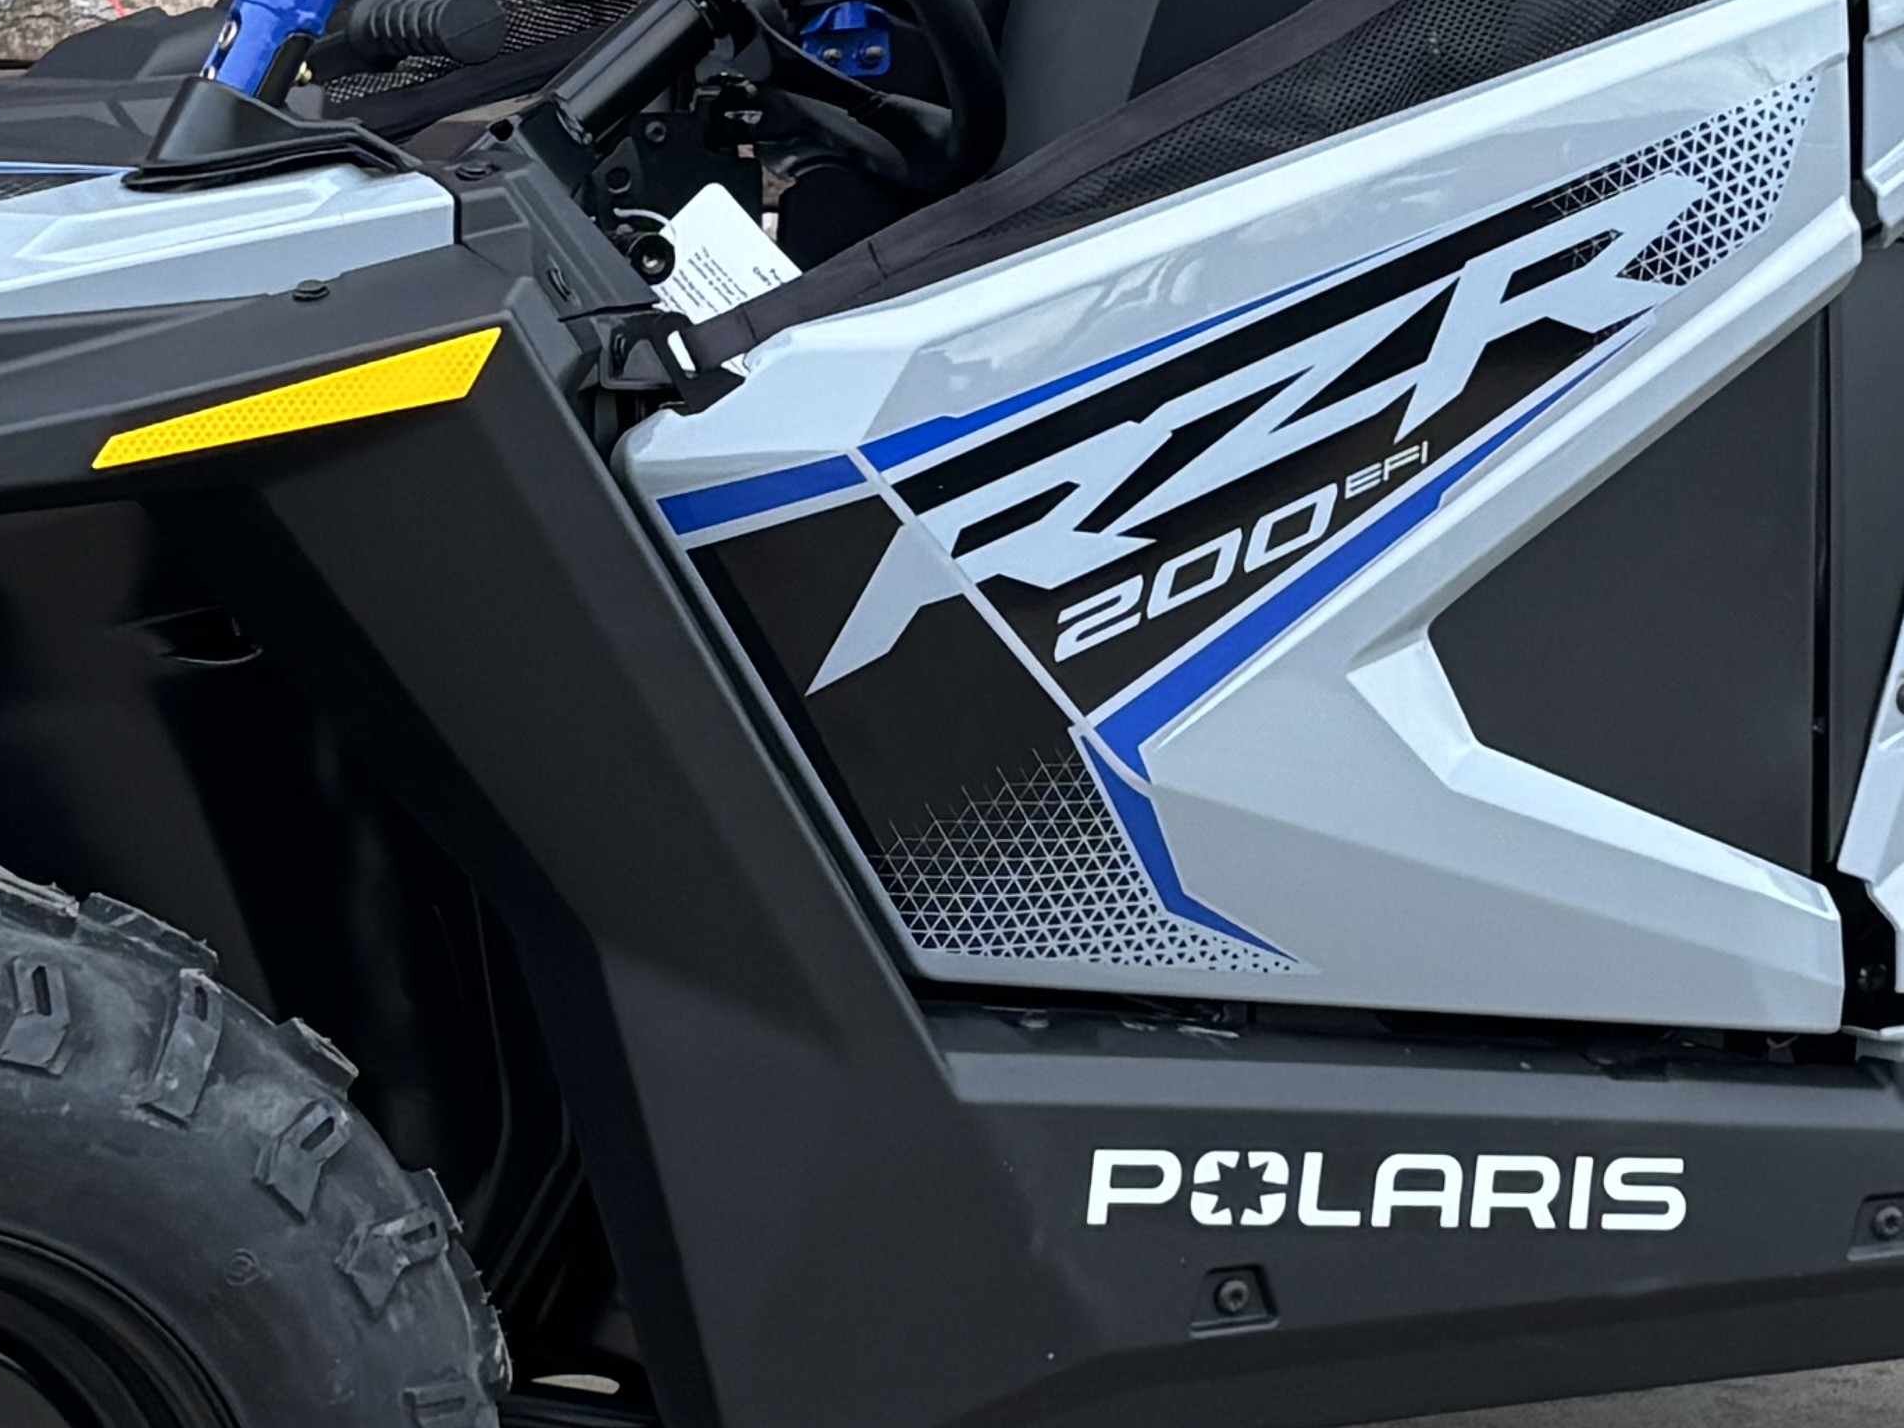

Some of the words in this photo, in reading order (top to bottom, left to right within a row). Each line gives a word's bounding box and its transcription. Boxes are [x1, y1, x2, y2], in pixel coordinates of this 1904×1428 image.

[806, 172, 1704, 697] RZR
[1053, 484, 1338, 663] 200
[1344, 440, 1429, 500] EFI
[1086, 1148, 1688, 1232] POLARIS
